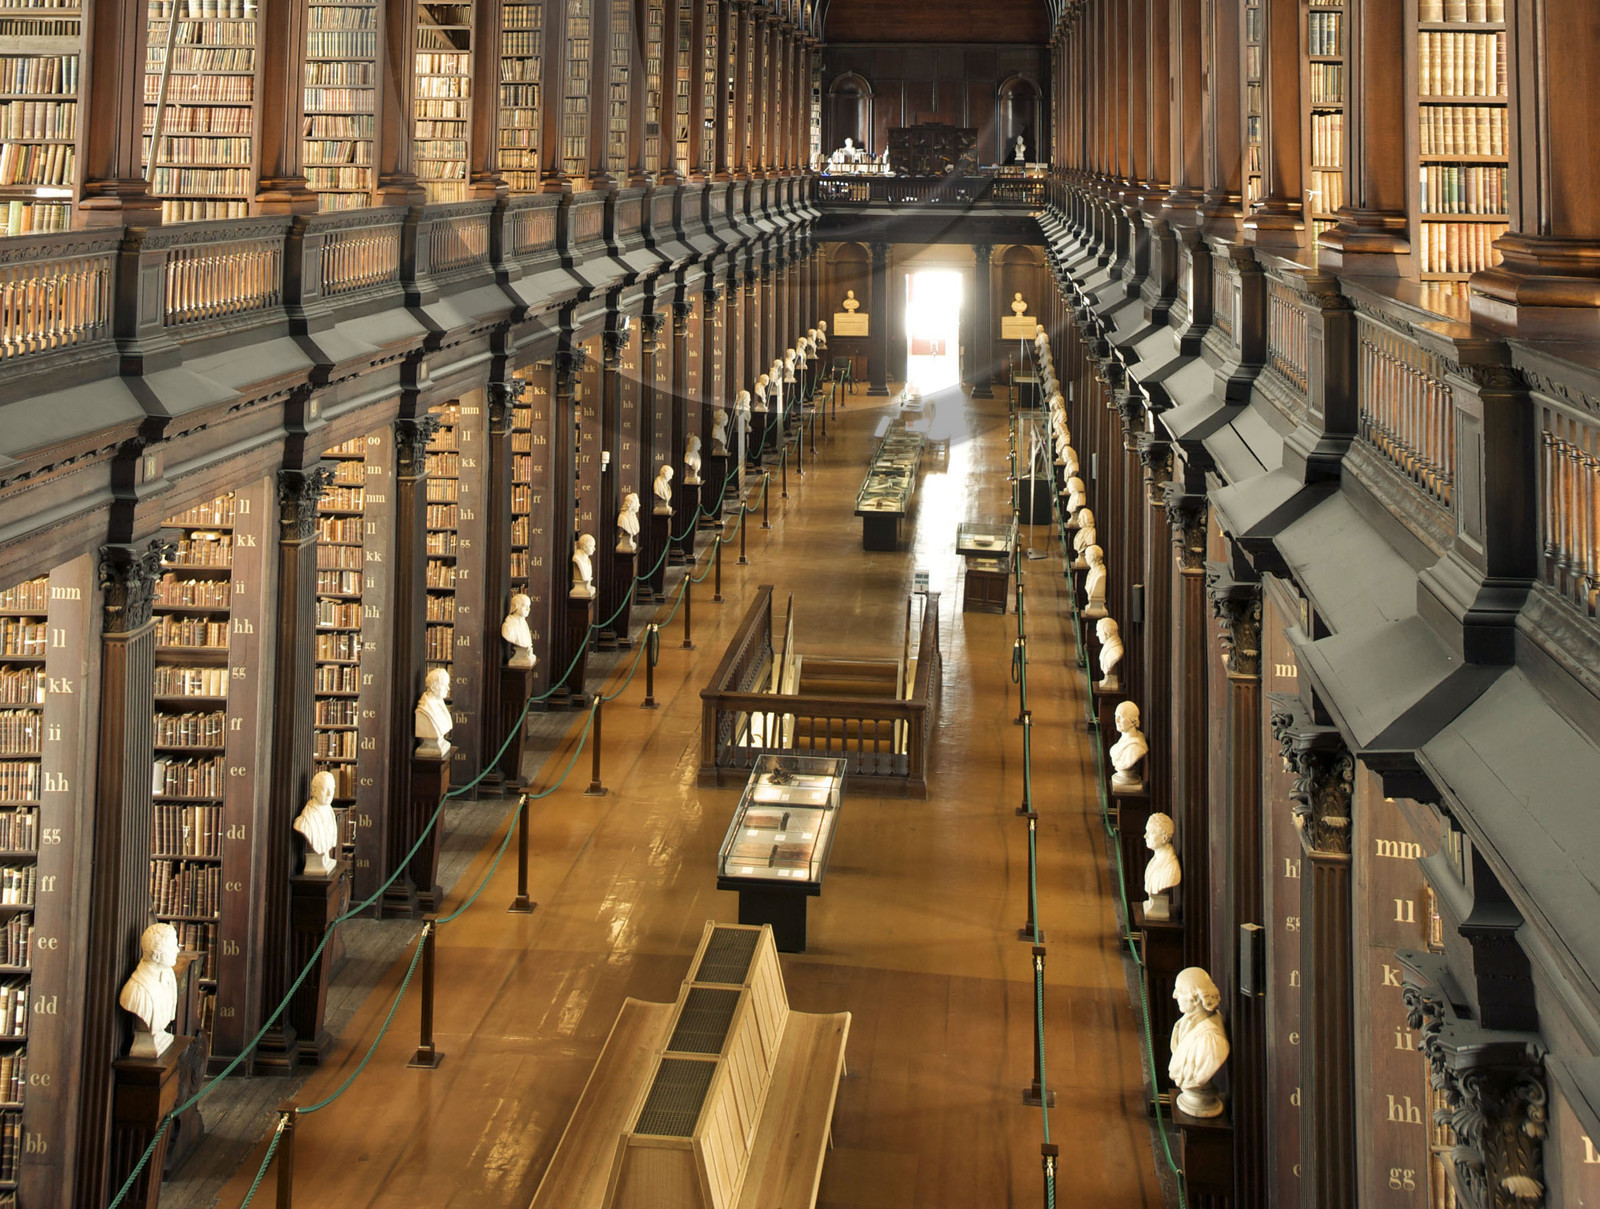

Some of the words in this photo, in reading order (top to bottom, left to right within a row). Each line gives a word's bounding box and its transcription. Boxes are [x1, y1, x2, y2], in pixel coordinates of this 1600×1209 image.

[367, 436, 381, 445] oo
[367, 465, 382, 475] nn
[366, 494, 385, 503] mm
[239, 499, 250, 514] ll
[367, 522, 376, 534] ll
[236, 534, 256, 547] kk
[366, 551, 382, 562] kk
[235, 580, 245, 594] ii
[366, 577, 375, 588] ii
[51, 585, 81, 601] mm
[365, 605, 380, 618] hh
[233, 619, 254, 634] hh
[51, 629, 67, 648] ll
[365, 642, 376, 651] gg
[231, 666, 246, 679] gg
[1275, 663, 1297, 677] m
[49, 677, 73, 693] kk
[363, 674, 373, 685] ff
[363, 709, 376, 718] ee
[230, 717, 243, 731] ff
[48, 724, 61, 741] ii
[361, 738, 376, 750] dd
[230, 765, 246, 776] ee
[44, 772, 69, 792] hh
[360, 777, 373, 786] cc
[359, 814, 372, 827] bb
[42, 827, 61, 844] gg
[226, 825, 246, 840] dd
[1375, 838, 1421, 859] mm
[41, 875, 56, 892] ff
[225, 881, 242, 892] cc
[1393, 898, 1416, 923] ll
[38, 936, 58, 950] ee
[222, 940, 240, 956] bb
[1289, 969, 1300, 986] f
[1382, 964, 1400, 986] k
[34, 995, 58, 1015] dd
[219, 1005, 235, 1017] aa
[1289, 1031, 1300, 1044] e
[1394, 1026, 1415, 1051] ii
[30, 1073, 50, 1086] cc
[1290, 1088, 1300, 1106] d
[1386, 1094, 1422, 1124] hh
[25, 1133, 47, 1154] bb
[1293, 1166, 1300, 1178] c
[1389, 1167, 1415, 1189] gg
